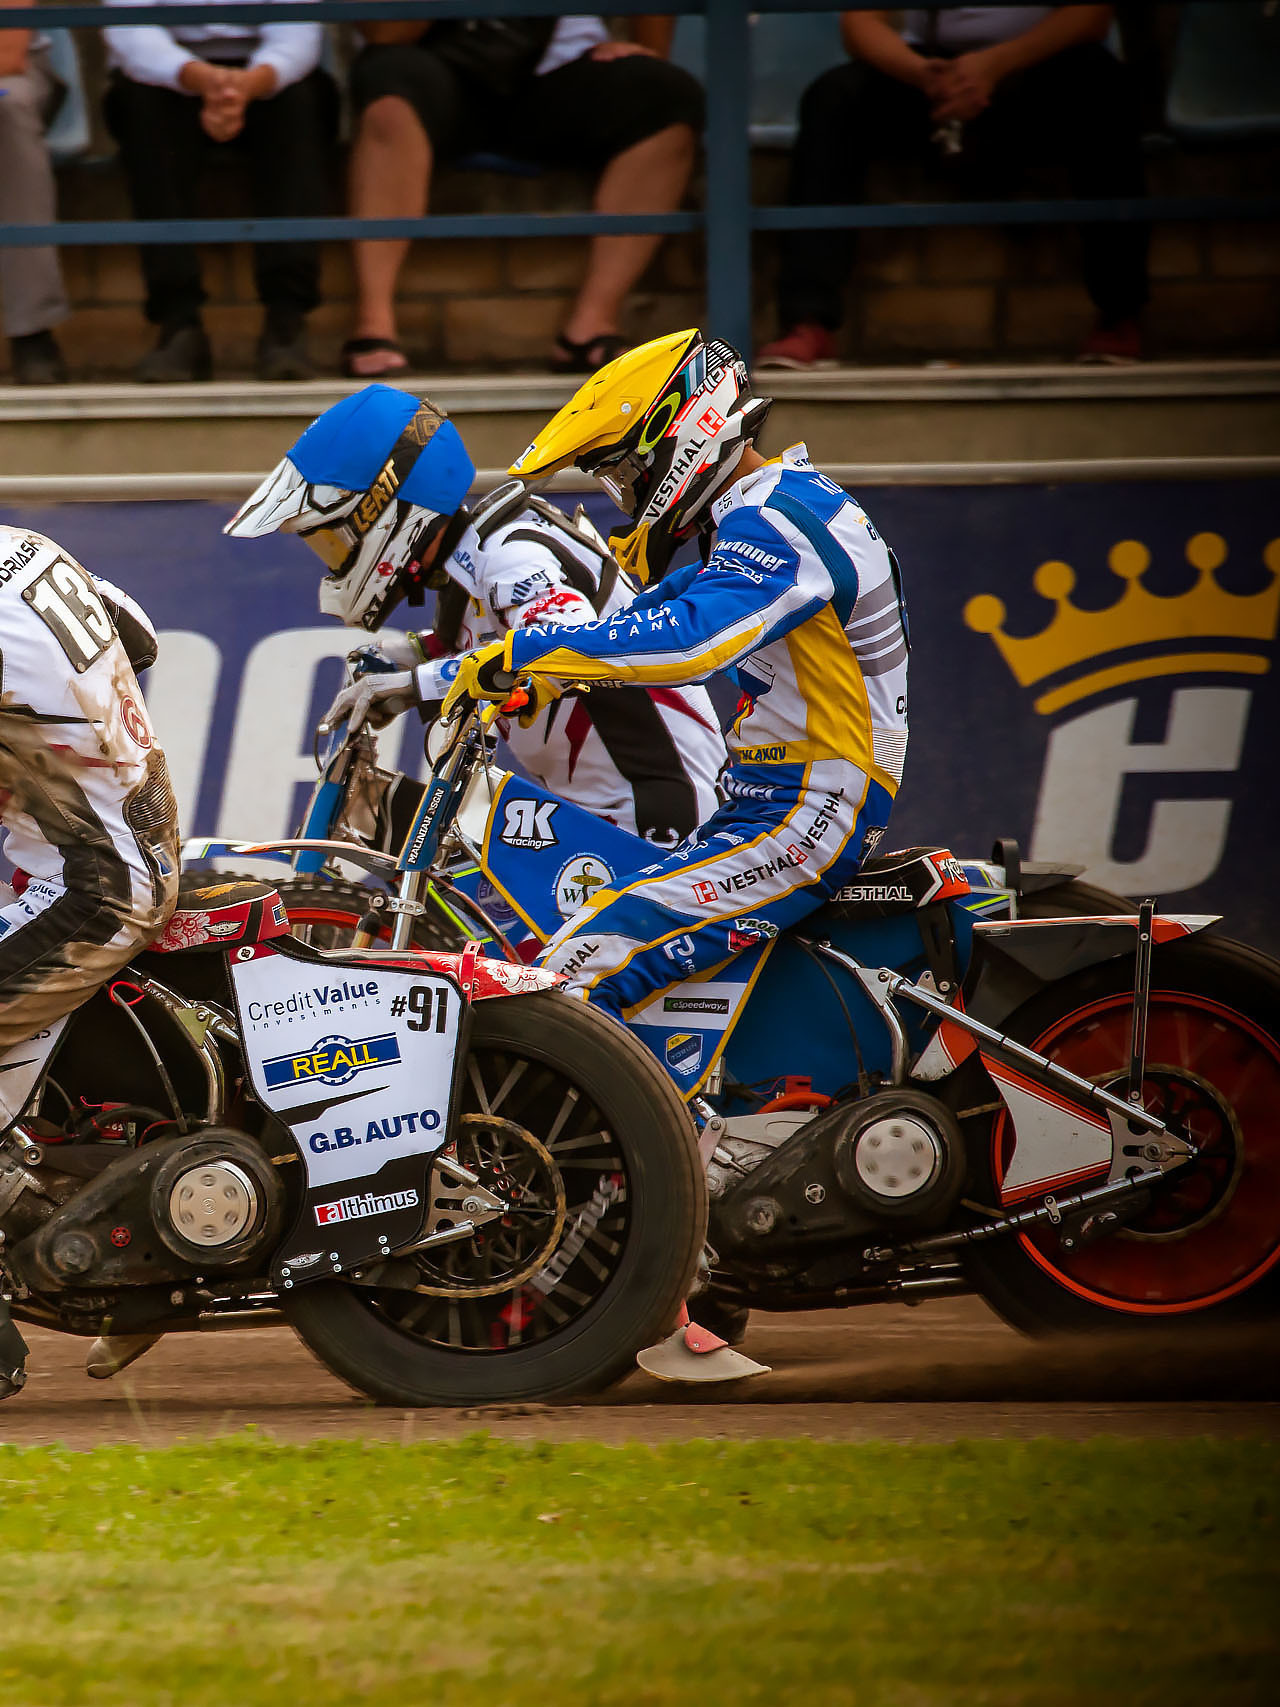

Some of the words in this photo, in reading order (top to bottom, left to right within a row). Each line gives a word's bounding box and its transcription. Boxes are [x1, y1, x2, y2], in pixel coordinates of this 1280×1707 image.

[353, 458, 400, 533] LEATT
[645, 438, 707, 519] VESTHAL
[32, 561, 113, 661] 13
[608, 617, 680, 641] BANK
[512, 838, 544, 850] racing
[718, 849, 801, 894] VESTHAL
[829, 886, 914, 902] ESTHAL
[248, 991, 313, 1021] Credit
[313, 980, 380, 1006] Value
[390, 985, 449, 1034] #91
[292, 1045, 379, 1079] REALL
[309, 1127, 361, 1154] G.B.
[365, 1109, 441, 1143] AUTO
[317, 1190, 418, 1224] althimus
